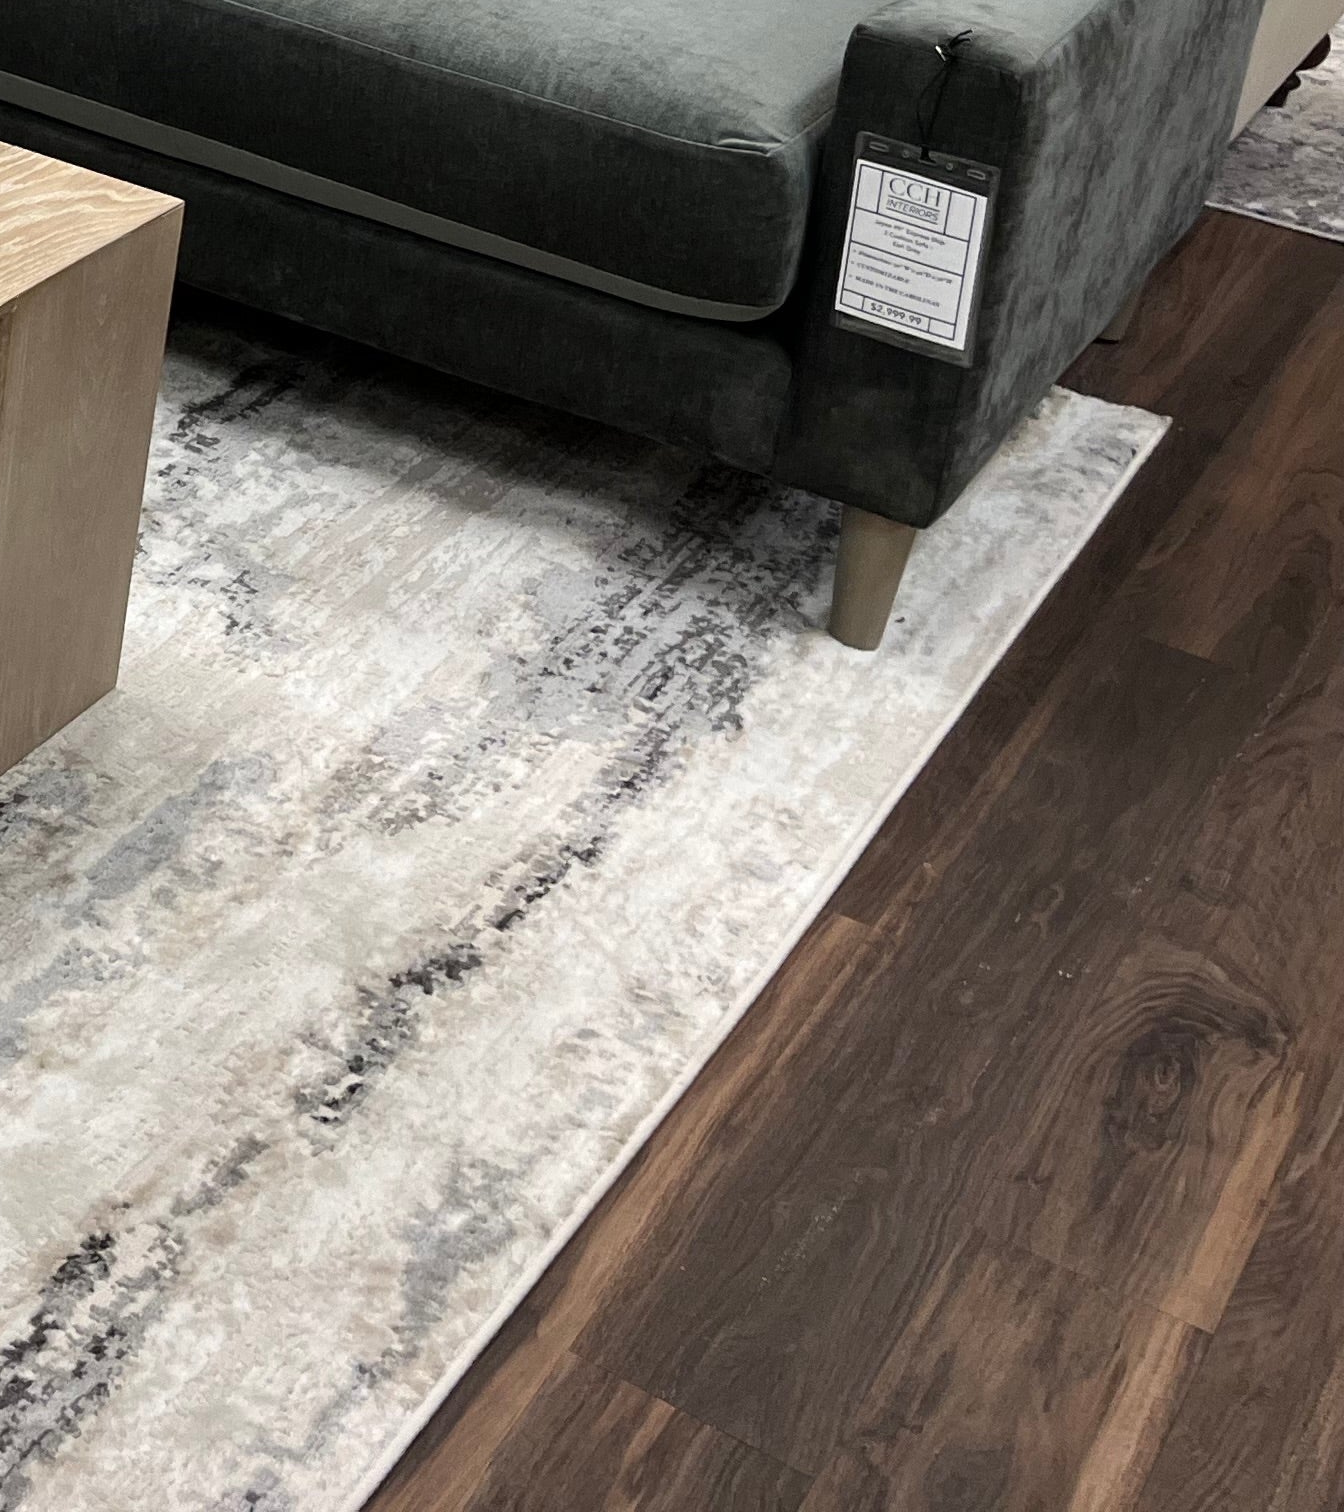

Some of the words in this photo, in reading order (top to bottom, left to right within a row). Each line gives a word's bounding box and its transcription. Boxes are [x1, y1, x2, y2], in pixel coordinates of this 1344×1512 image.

[889, 177, 941, 207] CCH
[886, 197, 939, 221] INTERIORS
[870, 302, 922, 325] $2,999.99
